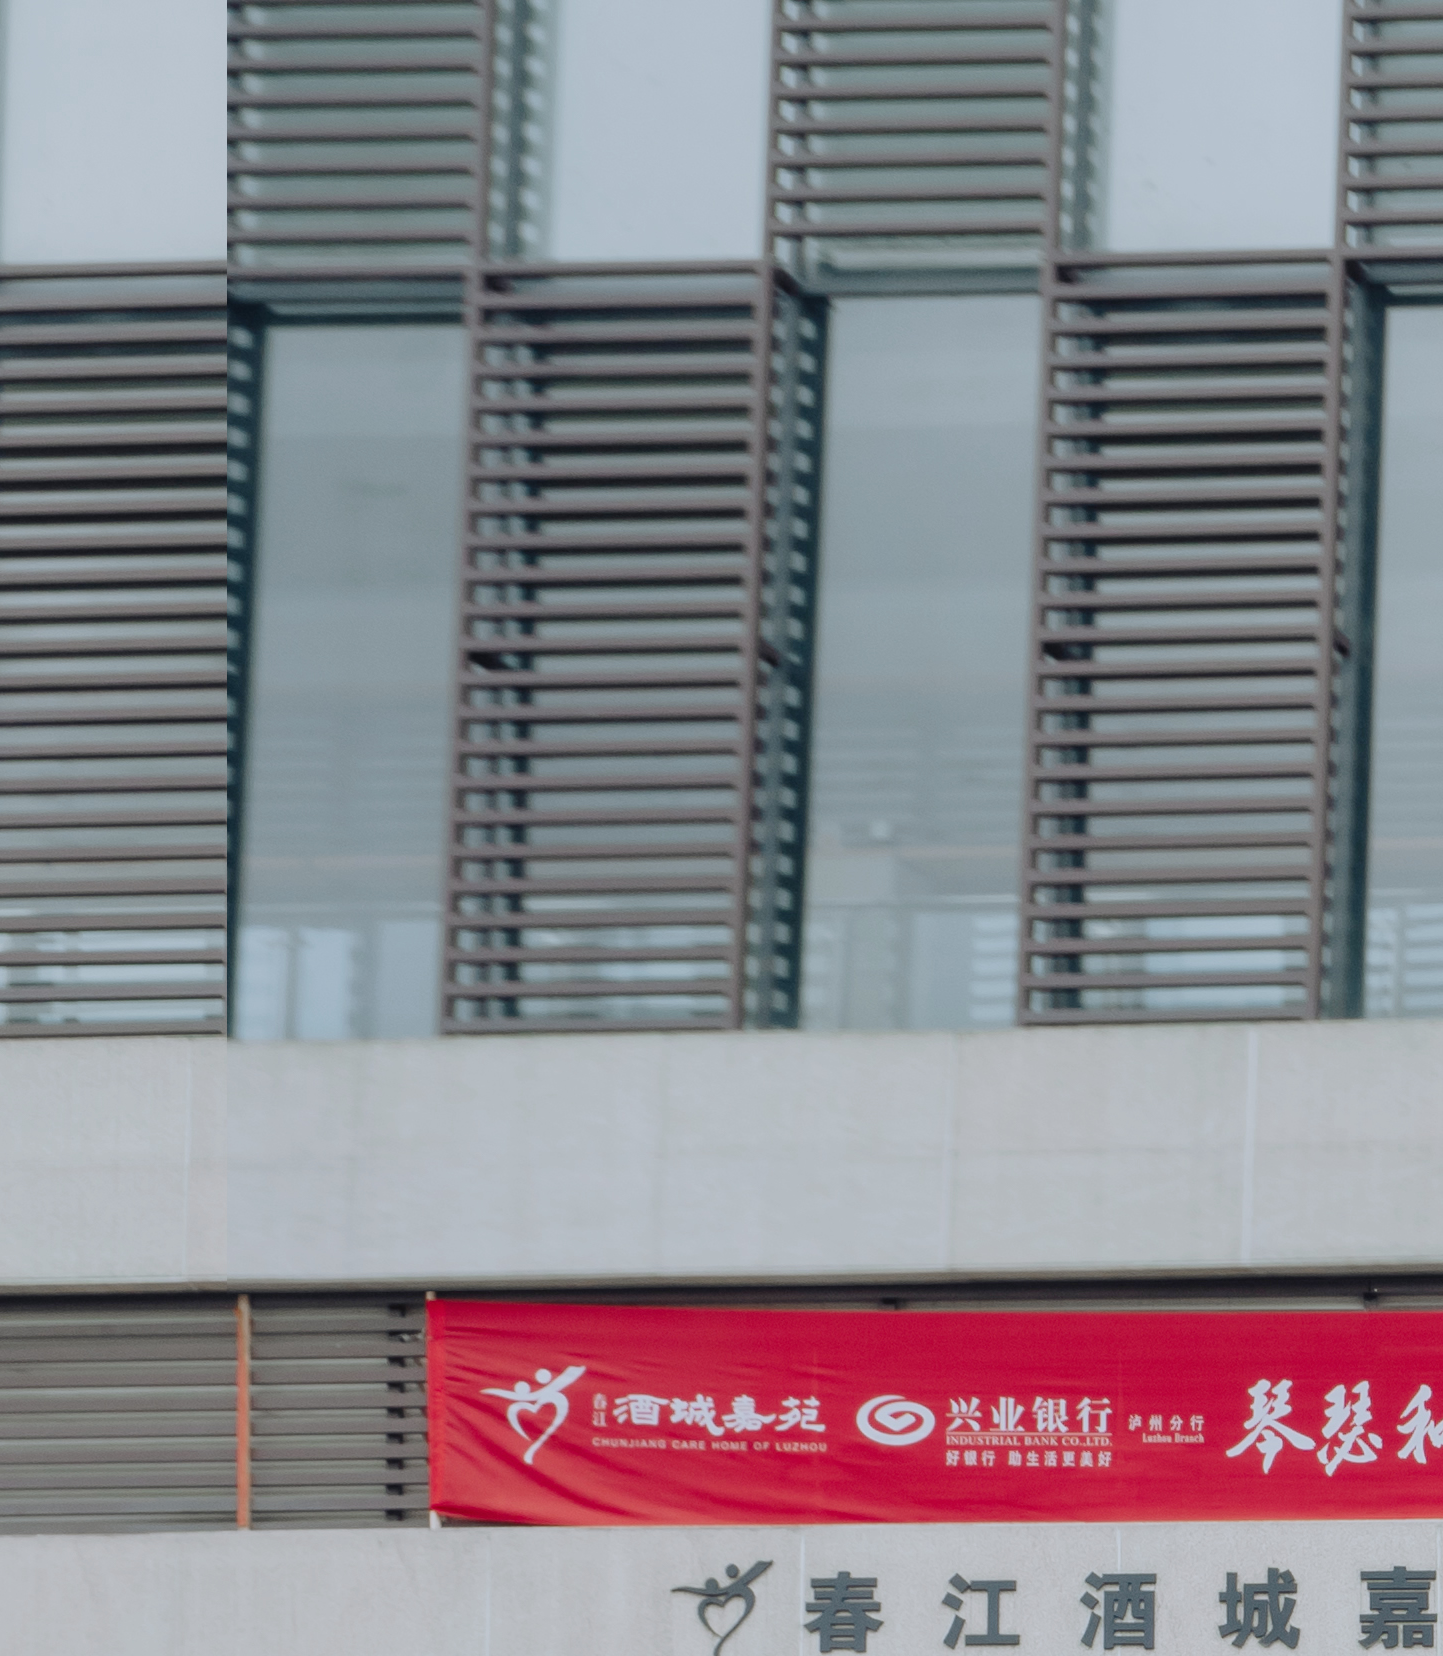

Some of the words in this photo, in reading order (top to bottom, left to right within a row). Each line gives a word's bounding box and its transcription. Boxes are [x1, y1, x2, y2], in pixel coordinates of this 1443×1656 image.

[613, 1393, 826, 1437] 酒城嘉苑
[946, 1396, 1113, 1433] 兴业银行
[1128, 1414, 1205, 1432] 泸州分行
[592, 1437, 667, 1450] CHUNJIANG
[672, 1439, 706, 1451] CARE
[712, 1440, 748, 1451] HOME
[753, 1441, 771, 1452] OF
[776, 1442, 828, 1453] LUZHOU
[946, 1434, 1021, 1447] INDUSTRIAL
[1024, 1435, 1058, 1447] BANK
[1142, 1432, 1173, 1444] Luzhou
[1175, 1432, 1205, 1444] Branch
[946, 1450, 996, 1467] 好银行
[1008, 1450, 1113, 1468] 助生活更美好
